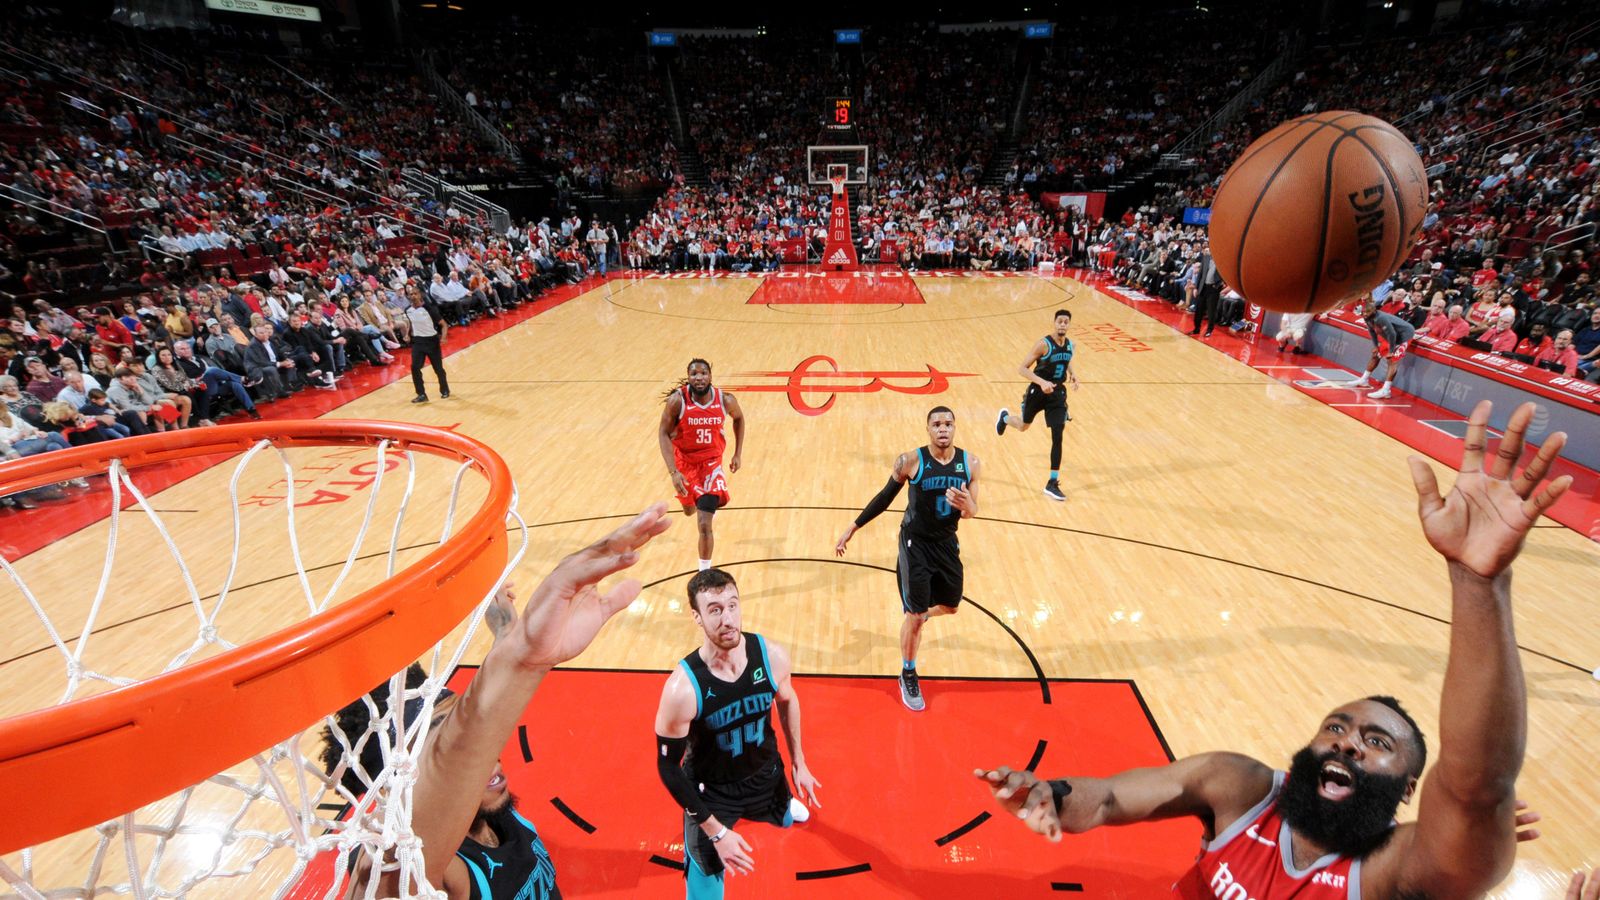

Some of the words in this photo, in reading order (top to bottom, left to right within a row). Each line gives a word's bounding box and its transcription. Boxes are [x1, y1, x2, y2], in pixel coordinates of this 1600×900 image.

[835, 108, 848, 123] 19
[1434, 377, 1473, 402] AT&T
[688, 416, 722, 425] ROCKETS
[696, 428, 713, 444] 35
[704, 700, 744, 731] BUZZ
[743, 692, 773, 715] CITY
[715, 716, 767, 758] 44
